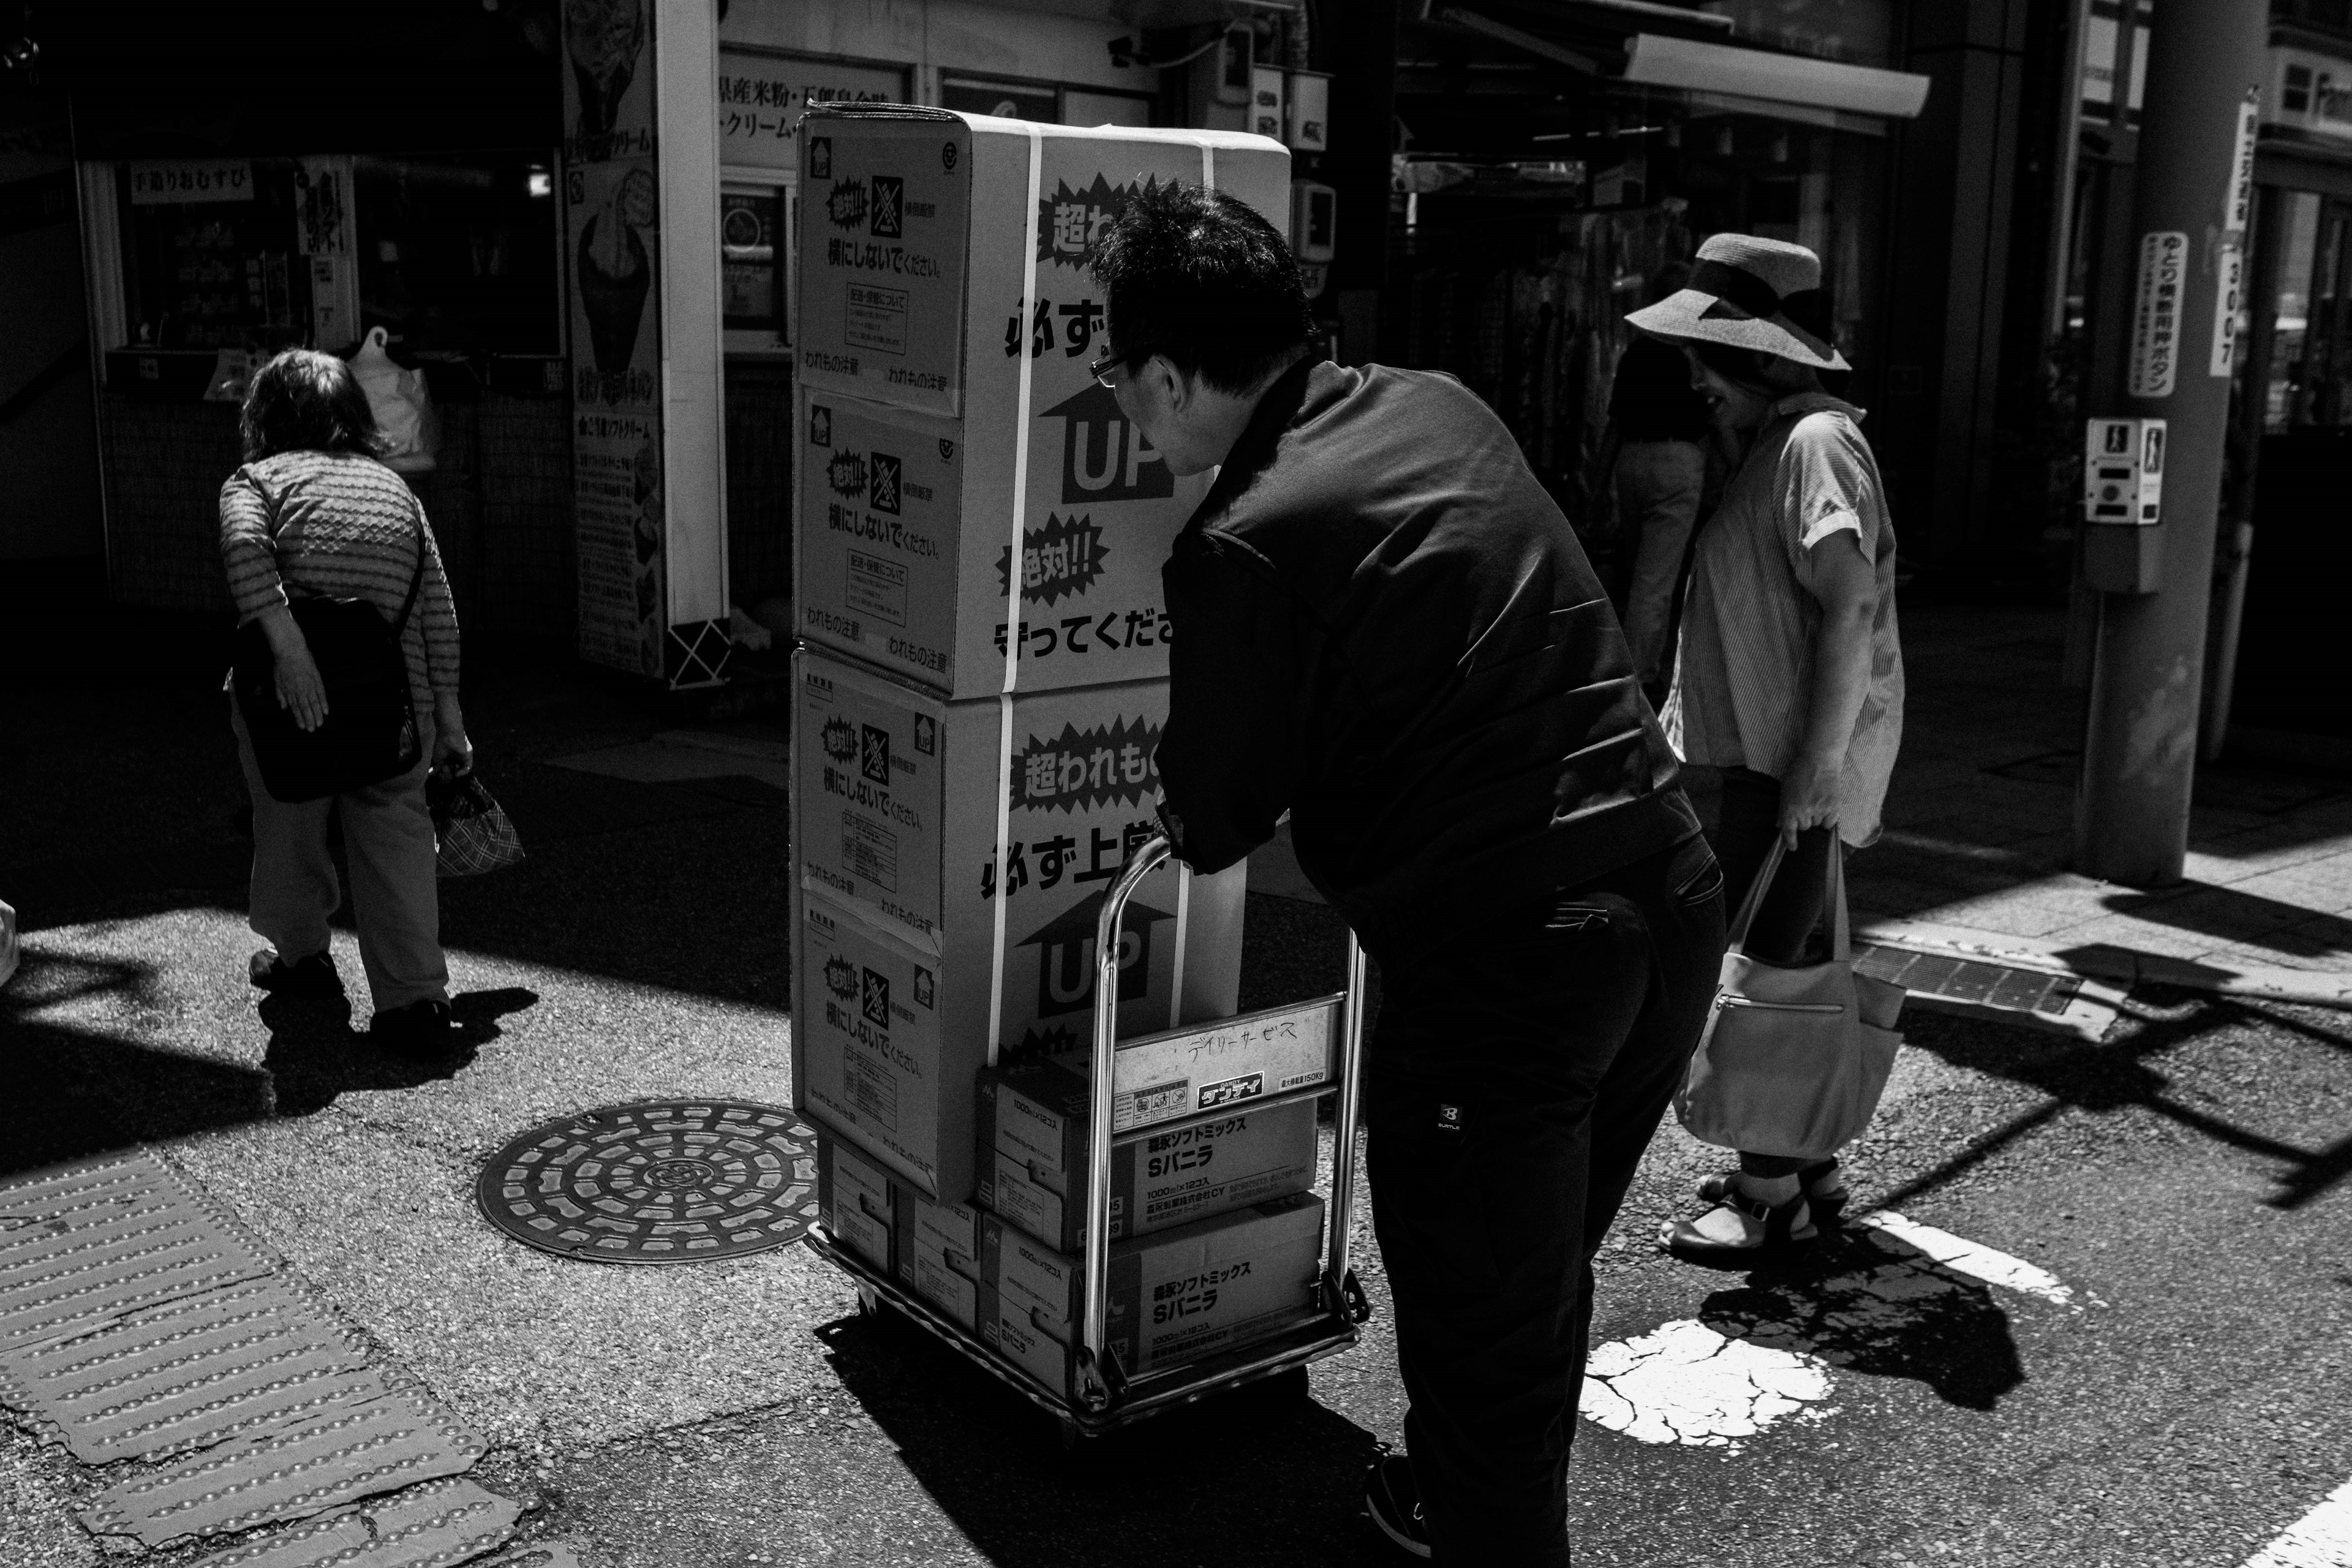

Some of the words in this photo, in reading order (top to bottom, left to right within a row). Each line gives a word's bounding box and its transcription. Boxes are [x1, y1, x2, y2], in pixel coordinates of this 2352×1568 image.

[816, 160, 826, 174] UP
[828, 237, 941, 279] 横にしないでください。
[2222, 262, 2239, 365] 3007
[805, 351, 859, 377] われもの注意
[889, 368, 947, 392] われもの注意
[815, 429, 826, 443] UP
[829, 502, 940, 560] 横にしないでください。
[1020, 531, 1091, 589] 絶対!!
[807, 606, 859, 643] われもの注意
[889, 637, 948, 674] われもの注意
[918, 734, 930, 750] UP
[823, 764, 923, 832] 横にしないでください。
[807, 861, 854, 896] われもの注意
[881, 898, 933, 935] われもの注意
[1049, 930, 1142, 1004] UP
[918, 989, 929, 1002] UP
[826, 998, 922, 1079] 横にしないでください。
[1220, 1079, 1242, 1088] DANDY
[810, 1087, 857, 1125] われもの注意
[882, 1134, 933, 1175] われもの注意
[1147, 1117, 1248, 1155] 森永ソフトミックス
[1147, 1144, 1213, 1178] Sバニラ
[1153, 1261, 1252, 1302] 森永ソフトミックス
[1153, 1288, 1218, 1325] Sバニラ
[1001, 1330, 1026, 1355] Sバニラ
